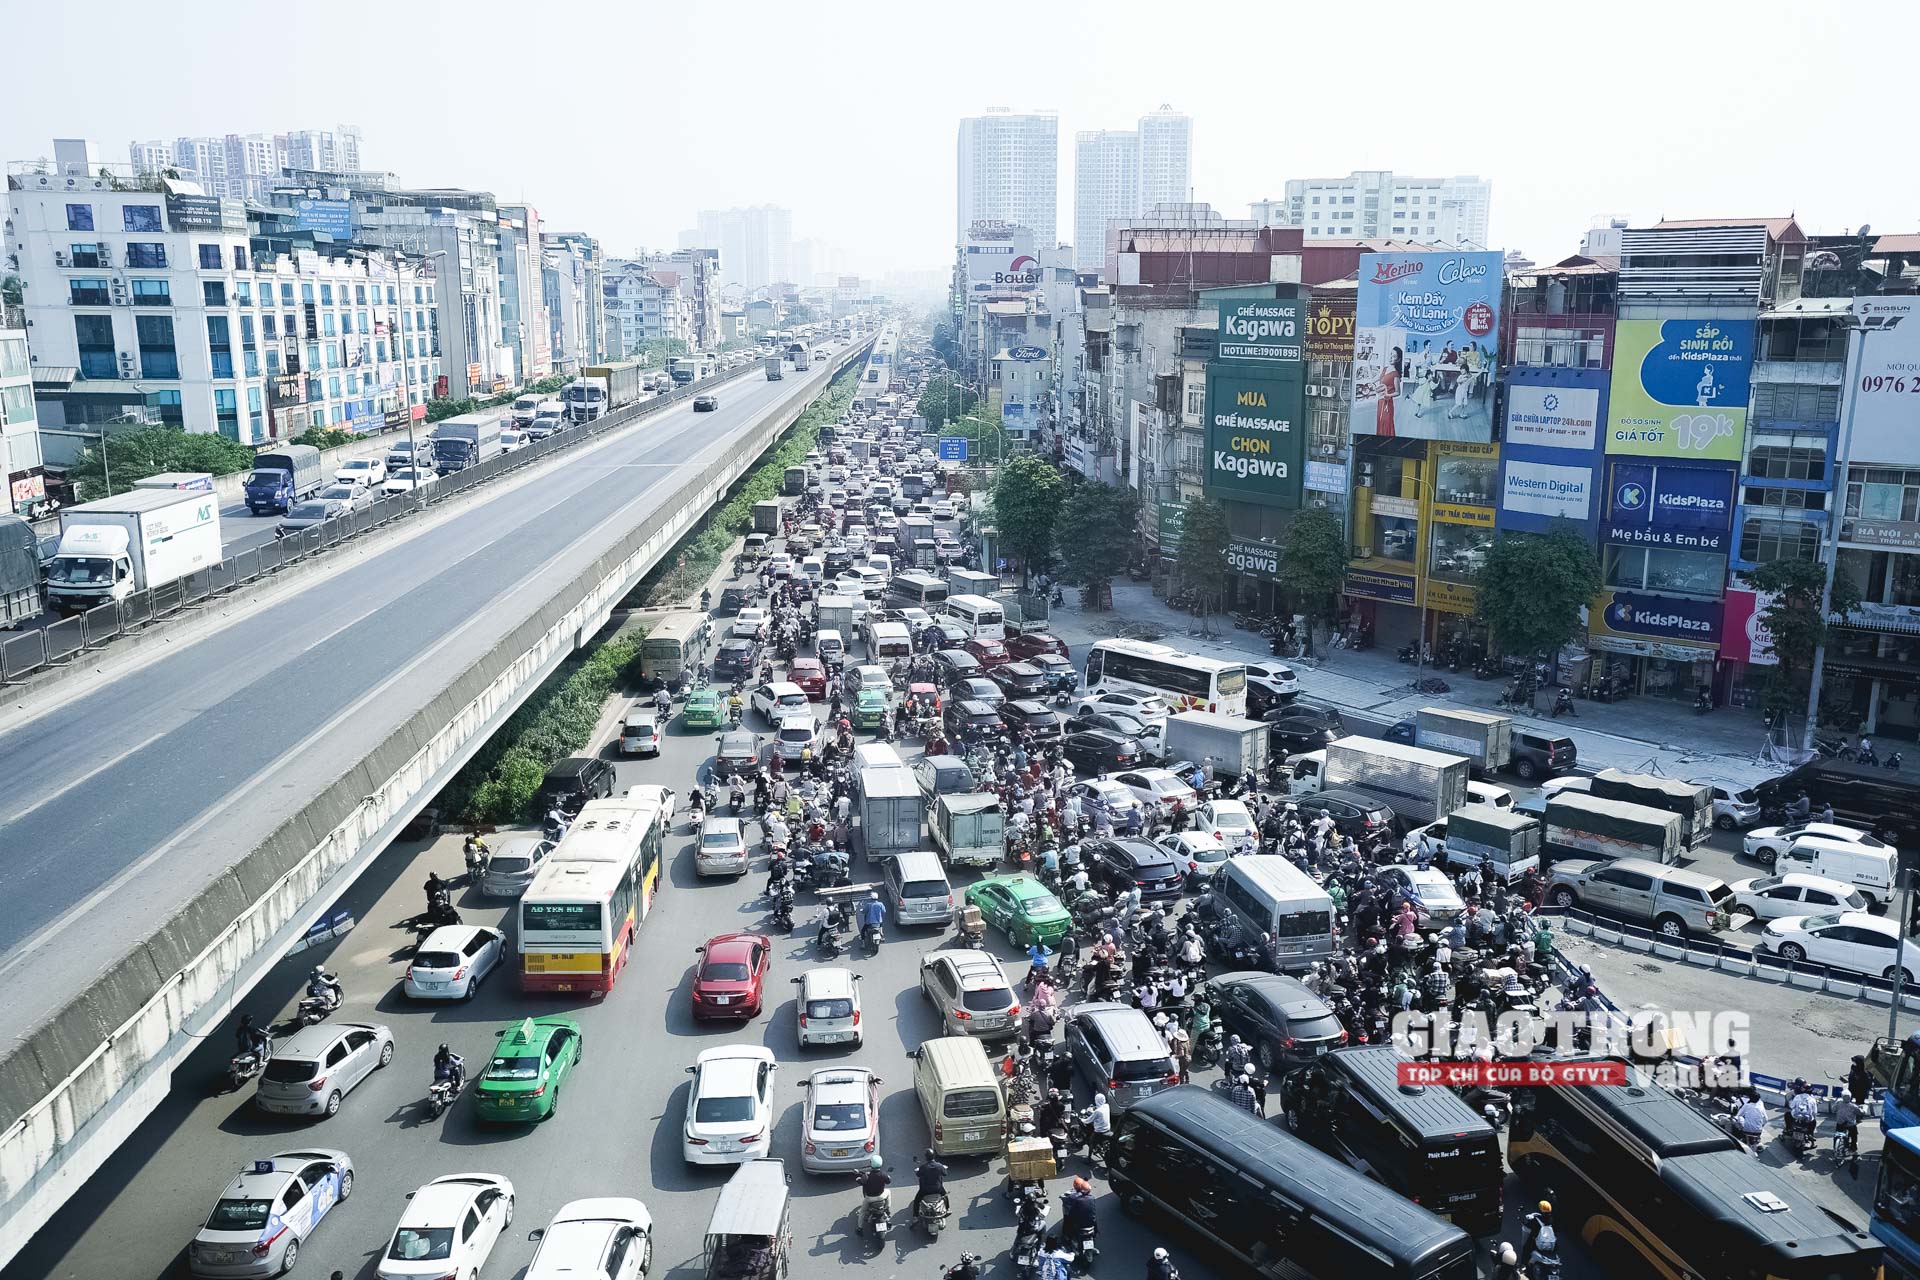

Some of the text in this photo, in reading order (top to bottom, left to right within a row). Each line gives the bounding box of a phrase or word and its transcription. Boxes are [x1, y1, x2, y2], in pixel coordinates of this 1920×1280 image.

[972, 220, 1006, 228] HOTEL
[995, 271, 1040, 284] Bauer
[1376, 258, 1487, 285] Merino Celano
[1398, 292, 1421, 305] Kem
[1237, 303, 1295, 317] GHẾ MASSAGE
[1226, 315, 1296, 341] Kagawa
[1680, 335, 1733, 350] SINH RỒI
[1015, 346, 1040, 358] Ford
[1681, 351, 1728, 361] KidsPlaza
[1862, 375, 1905, 393] 0976
[1237, 391, 1267, 407] MUA
[1215, 412, 1290, 432] GHẾ MASSAGE
[1540, 416, 1561, 425] LAPTOP
[1615, 429, 1637, 441] GIÁ
[1640, 427, 1664, 442] TỐT
[1231, 436, 1270, 457] CHỌN
[1214, 451, 1288, 478] Kagawa
[1508, 475, 1583, 494] Western Digital
[1659, 493, 1724, 509] KidsPlaza
[1611, 527, 1719, 548] Mẹ bầu & Em bé
[1229, 542, 1278, 559] GHẾ MASSAGE
[1635, 611, 1711, 632] KidsPlaza
